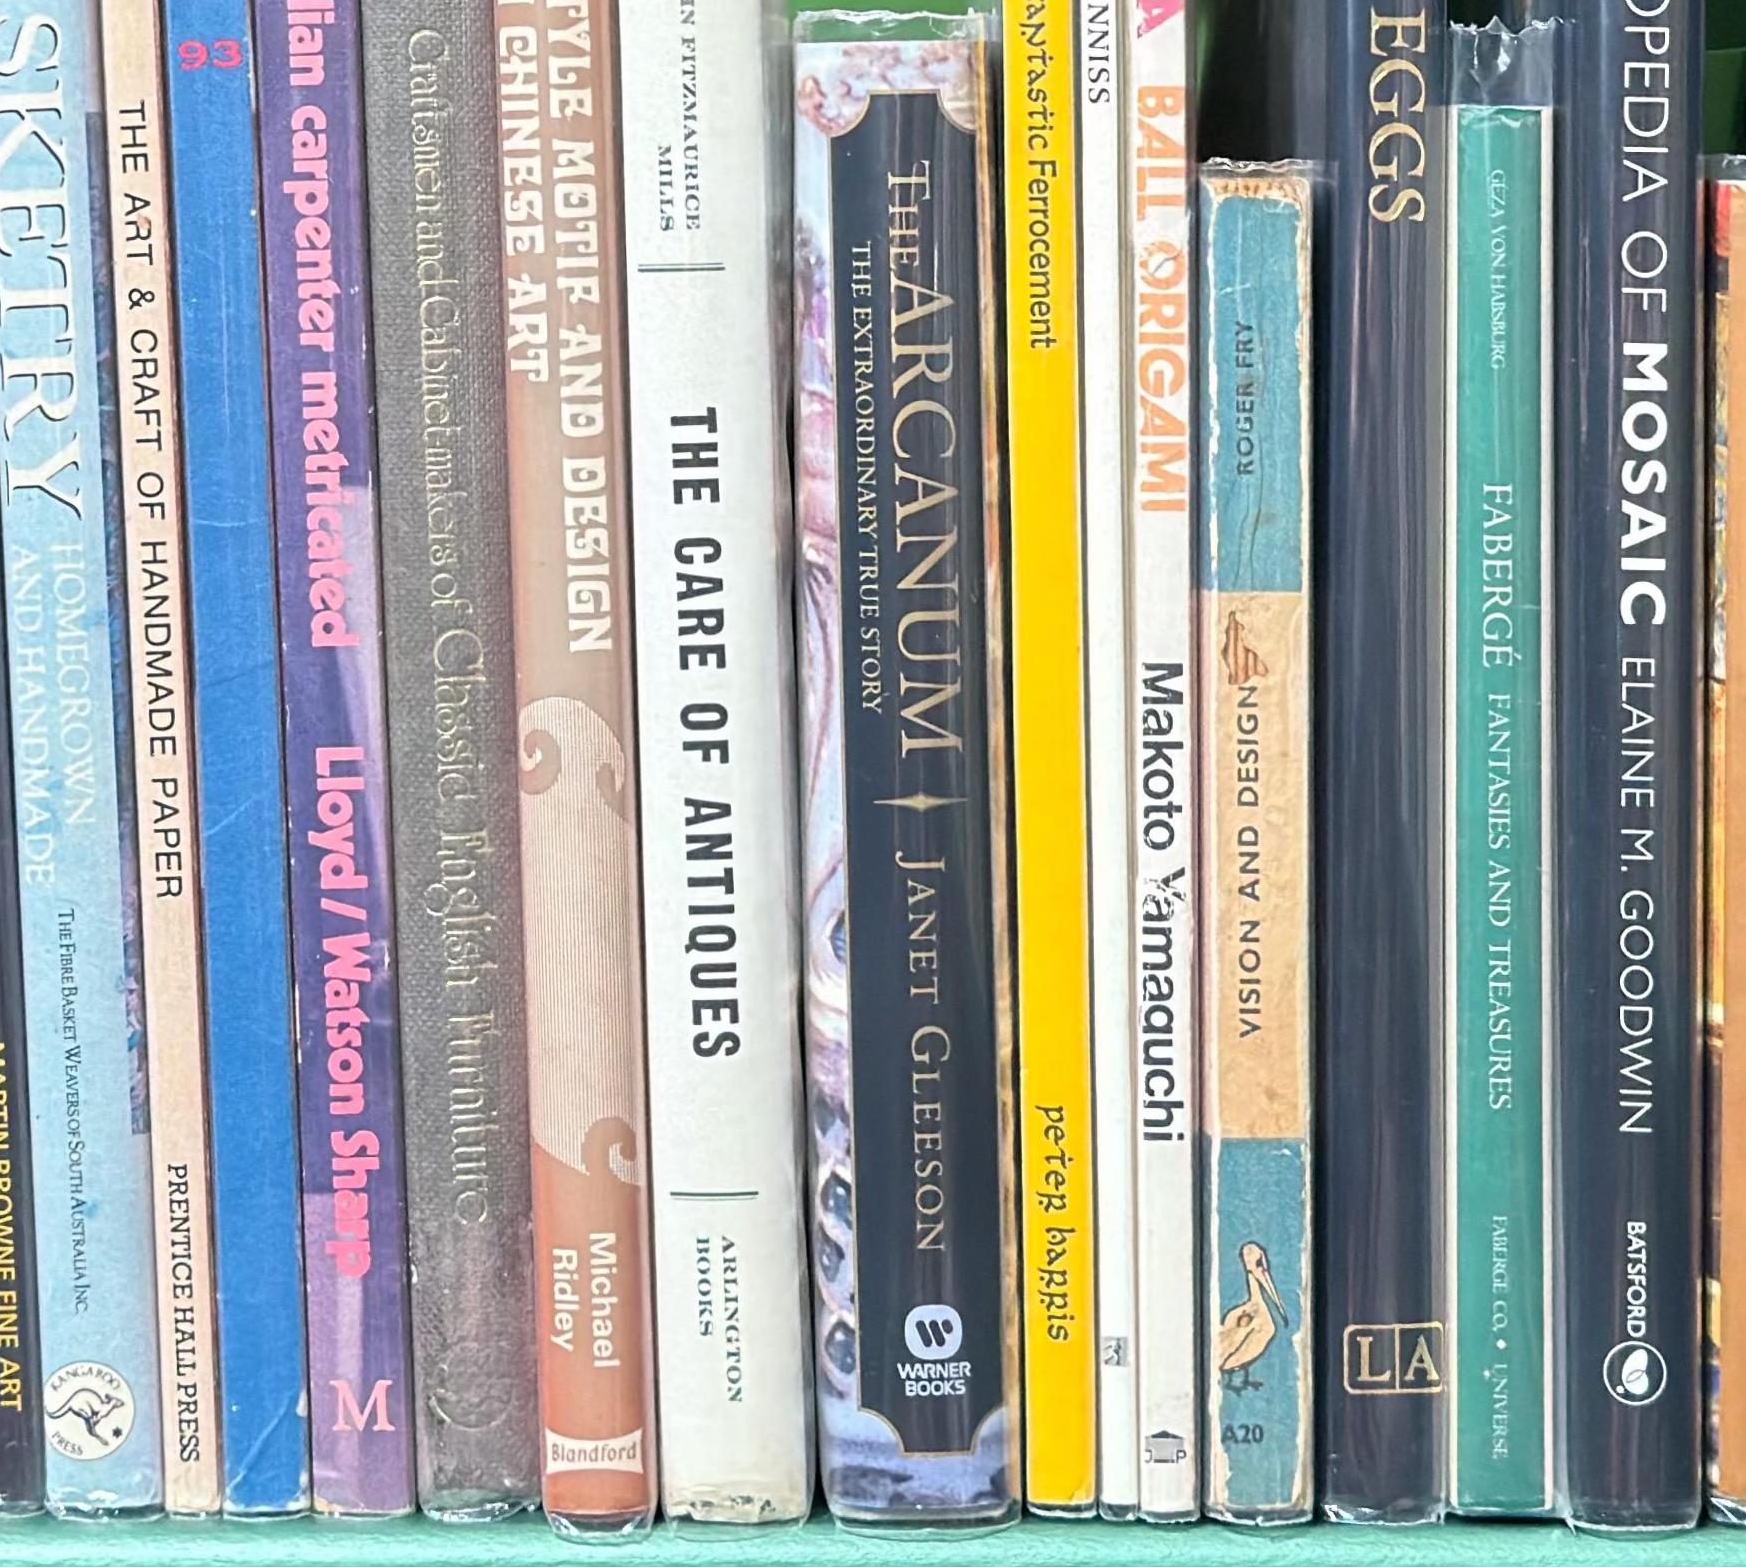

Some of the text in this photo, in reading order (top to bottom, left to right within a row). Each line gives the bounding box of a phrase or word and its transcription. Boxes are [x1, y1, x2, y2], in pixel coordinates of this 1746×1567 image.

[176, 39, 244, 71] 93
[681, 36, 702, 232] FITZMAURICE
[1136, 85, 1187, 222] BALL
[1368, 8, 1427, 224] EGGS
[284, 104, 344, 354] carpenter
[498, 25, 550, 384] CHINESE ART
[551, 137, 602, 306] MOTIF
[657, 145, 676, 232] MILLS
[1026, 158, 1059, 350] Ferrocement
[1138, 240, 1188, 513] ORIGAMI
[1490, 226, 1510, 370] VON HABSBURG
[1235, 319, 1256, 477] ROGER FRY
[1620, 341, 1669, 627] MOSAIC
[122, 192, 184, 900] ART CRAFT HANDMADE PAPER
[302, 371, 360, 648] metricated
[562, 456, 613, 655] DESIGN
[851, 305, 886, 715] EXTRAORDINARY TRUE STORY
[890, 271, 964, 759] ARCANUM
[17, 645, 56, 887] HANDMADE
[50, 542, 97, 828] HOMEGROWN
[1620, 656, 1655, 808] ELAINE
[672, 537, 741, 1059] CARE ANTIQUES
[1236, 685, 1263, 1040] VISION DESIGN
[1482, 482, 1522, 1110] FABERGÉ FANTASIES TREASURES
[1620, 828, 1655, 873] M.
[1138, 661, 1186, 1144] Makoto Yamaguchi
[59, 942, 83, 1118] FIBRE BASKET WEAVERS
[307, 746, 381, 1278] Lloyd Watson Sharp
[896, 851, 953, 1251] JANET GLEESON
[1619, 889, 1655, 1135] GOODWIN
[167, 1164, 201, 1463] PRENTICE HALL PRESS
[550, 1247, 580, 1352] Ridley
[589, 1232, 621, 1368] Michael
[694, 1237, 716, 1338] BOOKS
[720, 1234, 745, 1404] ARLINGTON
[896, 1362, 972, 1379] WARNER
[1626, 1220, 1648, 1339] BATSFORD
[329, 1379, 396, 1432] M
[550, 1442, 638, 1462] Blandford
[904, 1379, 967, 1396] BOOKS
